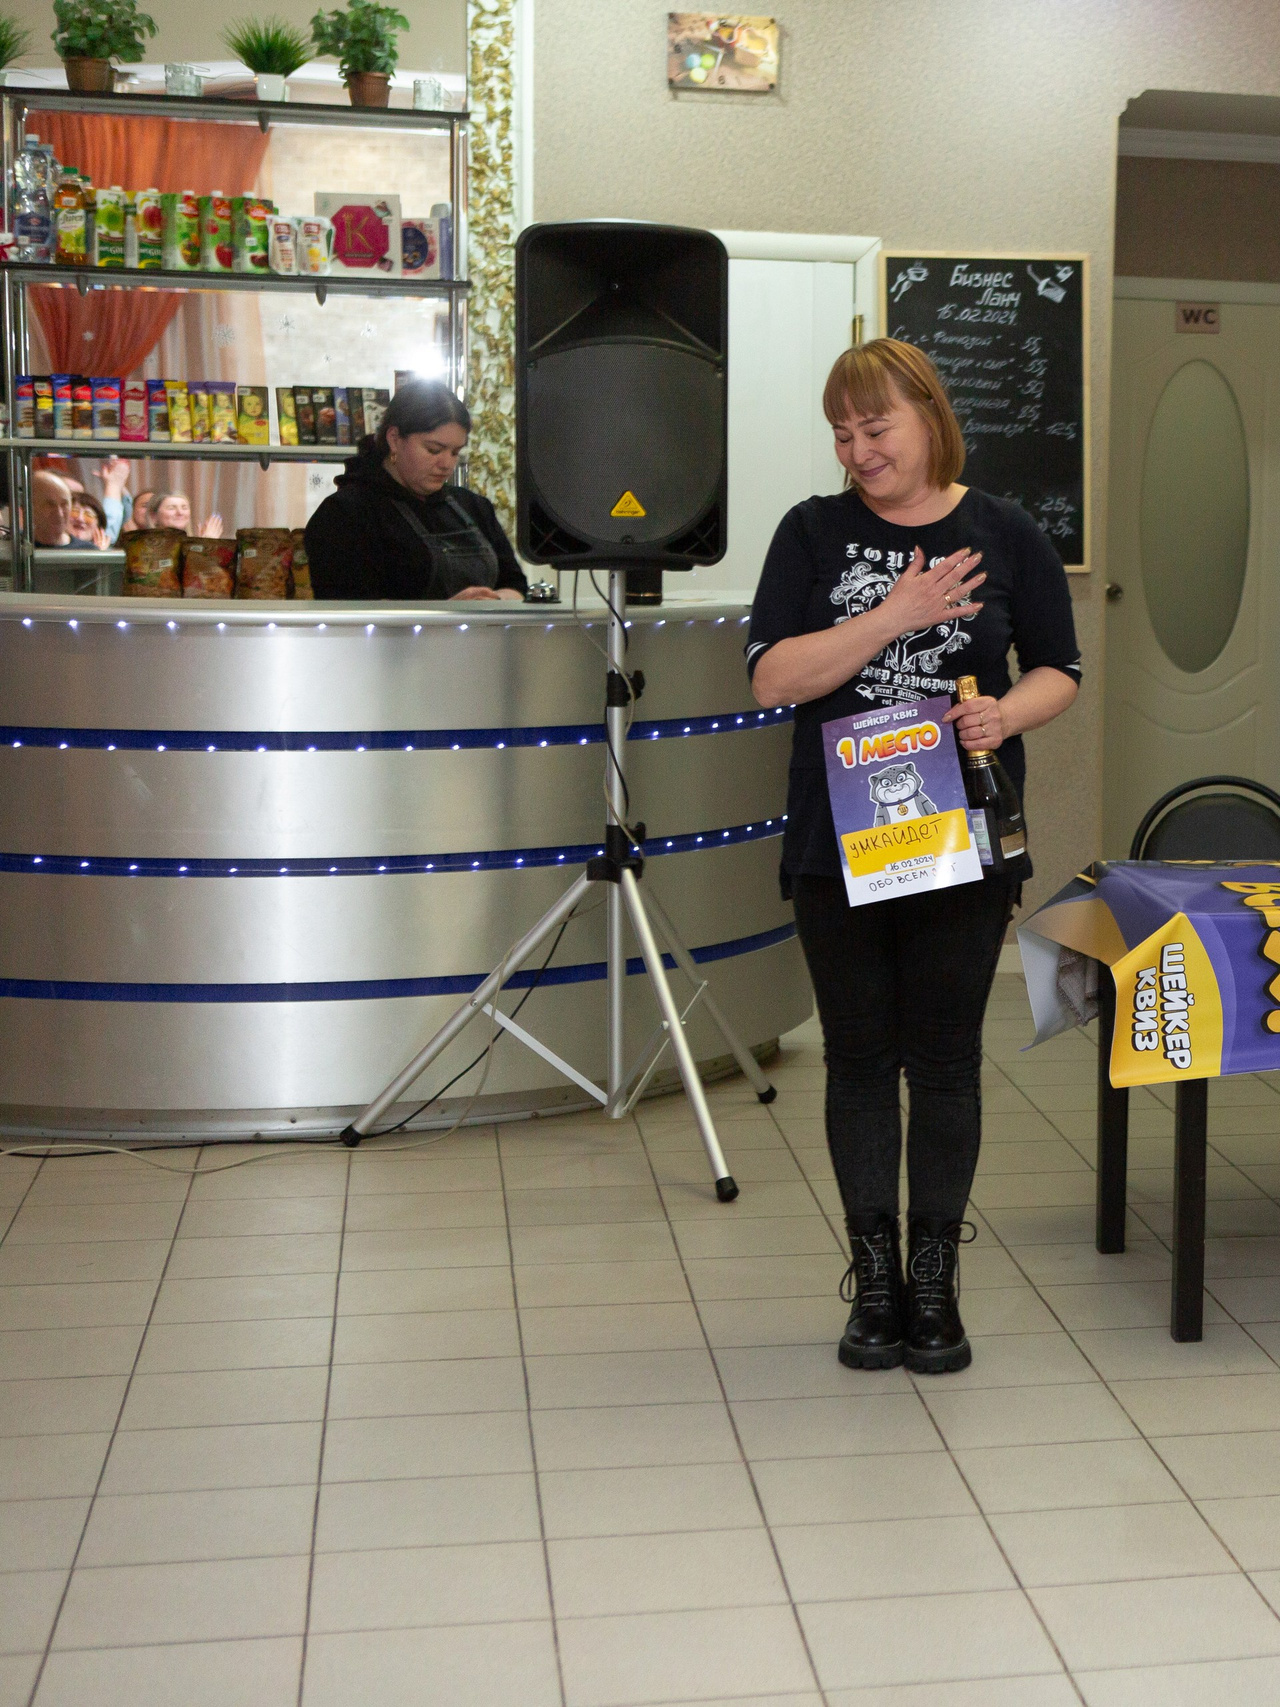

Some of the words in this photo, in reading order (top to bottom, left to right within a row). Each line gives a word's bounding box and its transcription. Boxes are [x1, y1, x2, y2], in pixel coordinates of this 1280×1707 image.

[950, 264, 1014, 288] Бизнес
[976, 287, 1022, 308] Ланч
[1183, 309, 1217, 325] WC
[853, 715, 890, 730] ШЕЙКЕР
[893, 708, 919, 721] КВИЗ
[838, 729, 855, 767] 1
[861, 723, 940, 764] МЕСТО
[868, 877, 894, 892] ОБО
[1133, 966, 1158, 1051] КВИЗ
[1160, 942, 1195, 1069] ШЕЙКЕР
